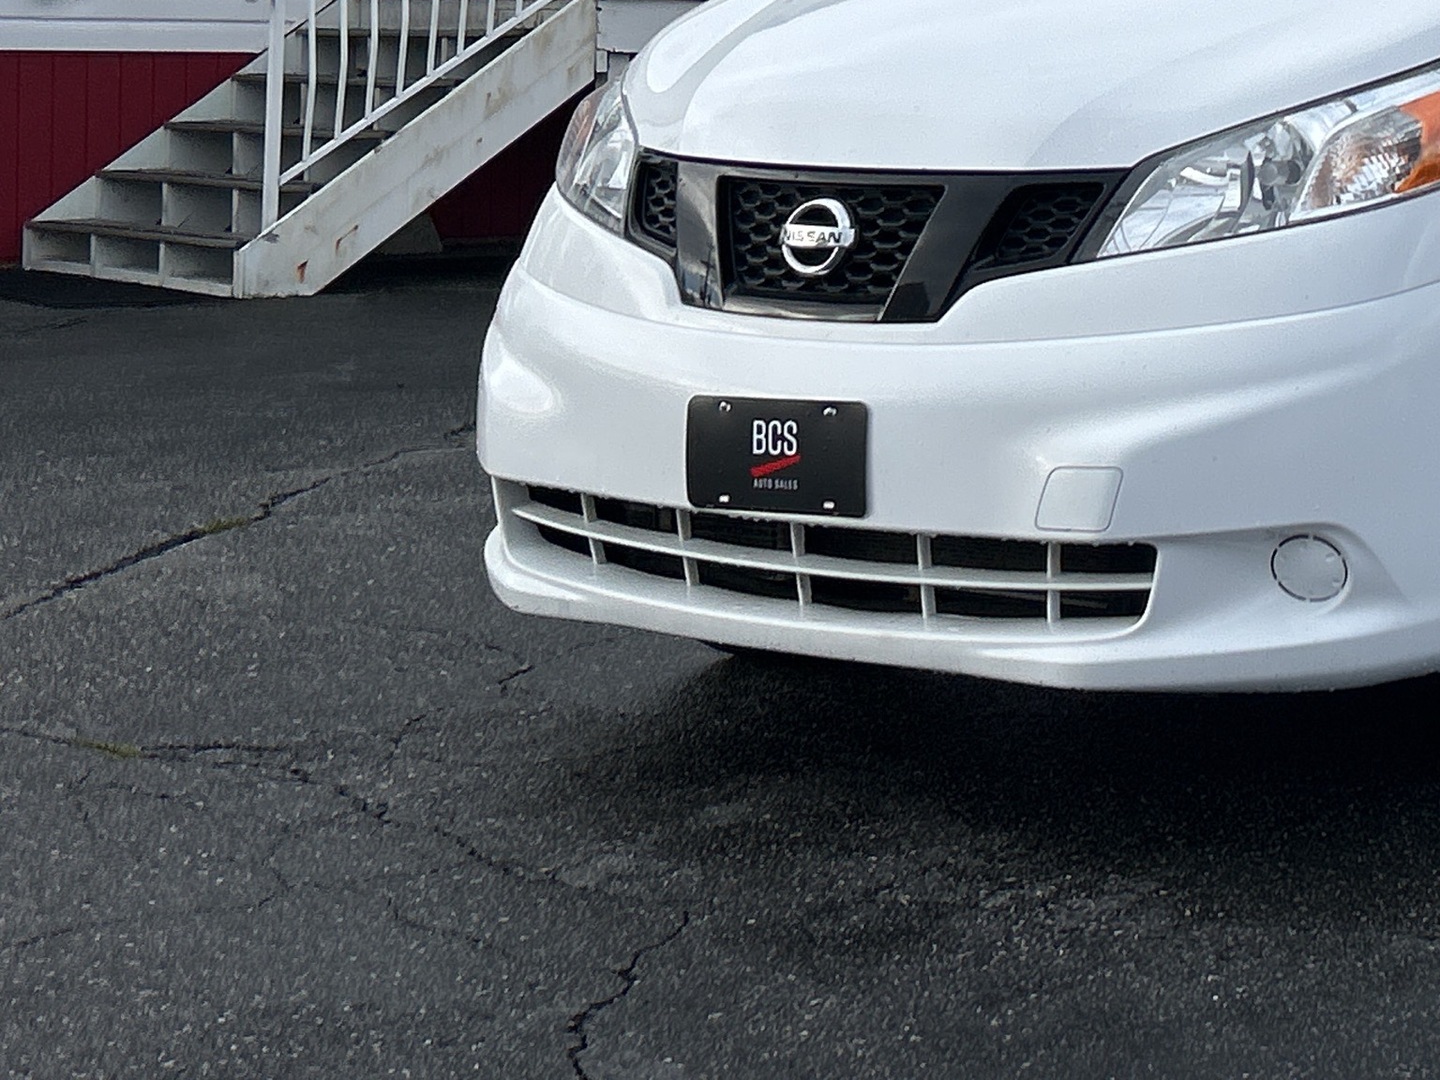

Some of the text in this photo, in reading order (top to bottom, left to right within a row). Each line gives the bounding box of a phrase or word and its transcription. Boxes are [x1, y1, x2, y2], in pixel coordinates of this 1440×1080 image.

[784, 230, 842, 243] NISSAN
[752, 420, 797, 456] BCS
[753, 478, 773, 490] AUTO
